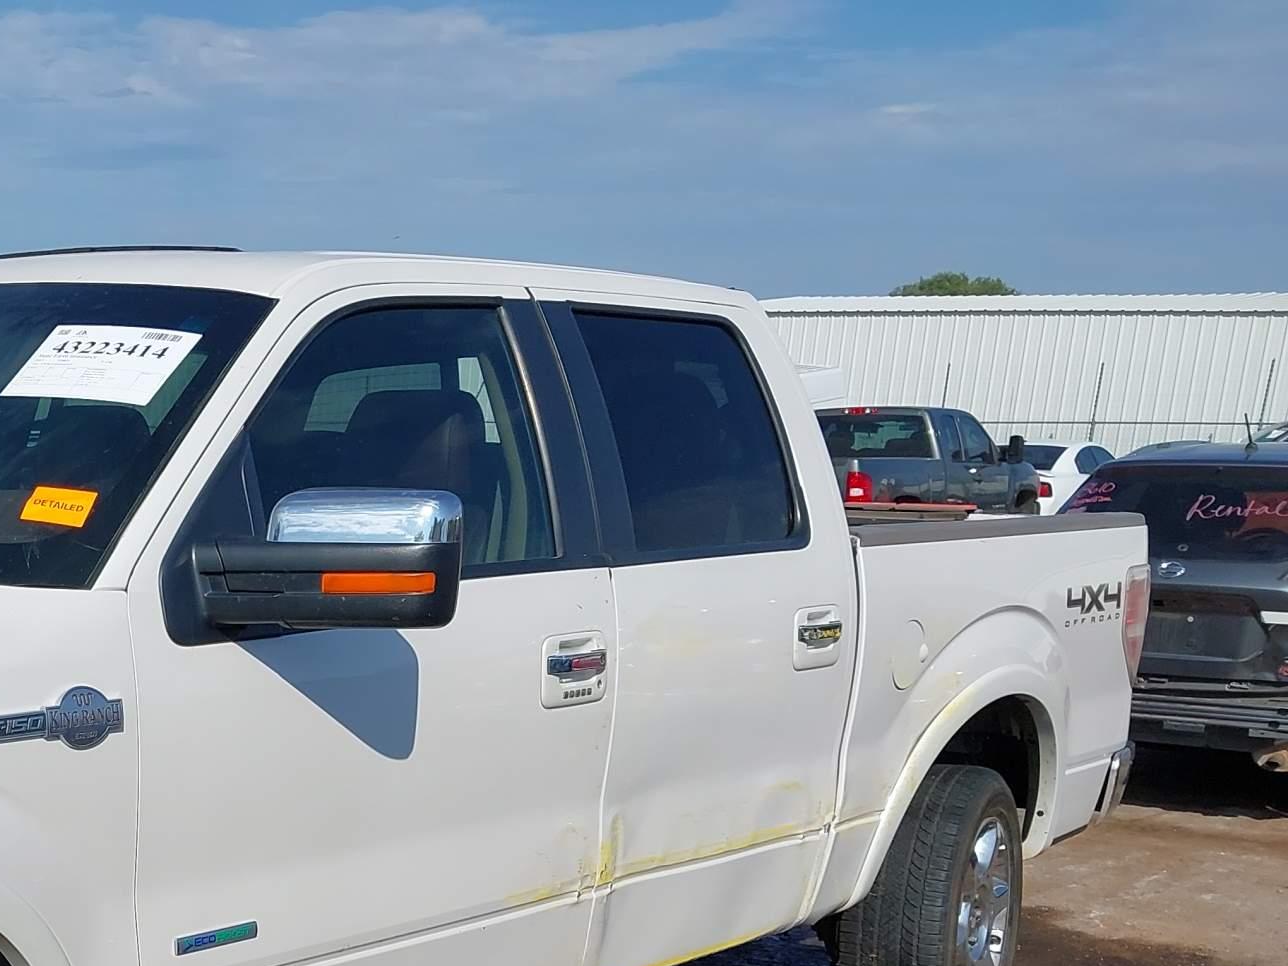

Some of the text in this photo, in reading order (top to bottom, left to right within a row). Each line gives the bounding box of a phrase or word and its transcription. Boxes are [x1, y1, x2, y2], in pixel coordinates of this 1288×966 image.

[52, 341, 170, 360] 43223414
[33, 499, 85, 512] DETAILED
[1186, 494, 1288, 521] Rental
[1064, 612, 1121, 628] OFF ROAD
[48, 703, 121, 729] KING RANCH
